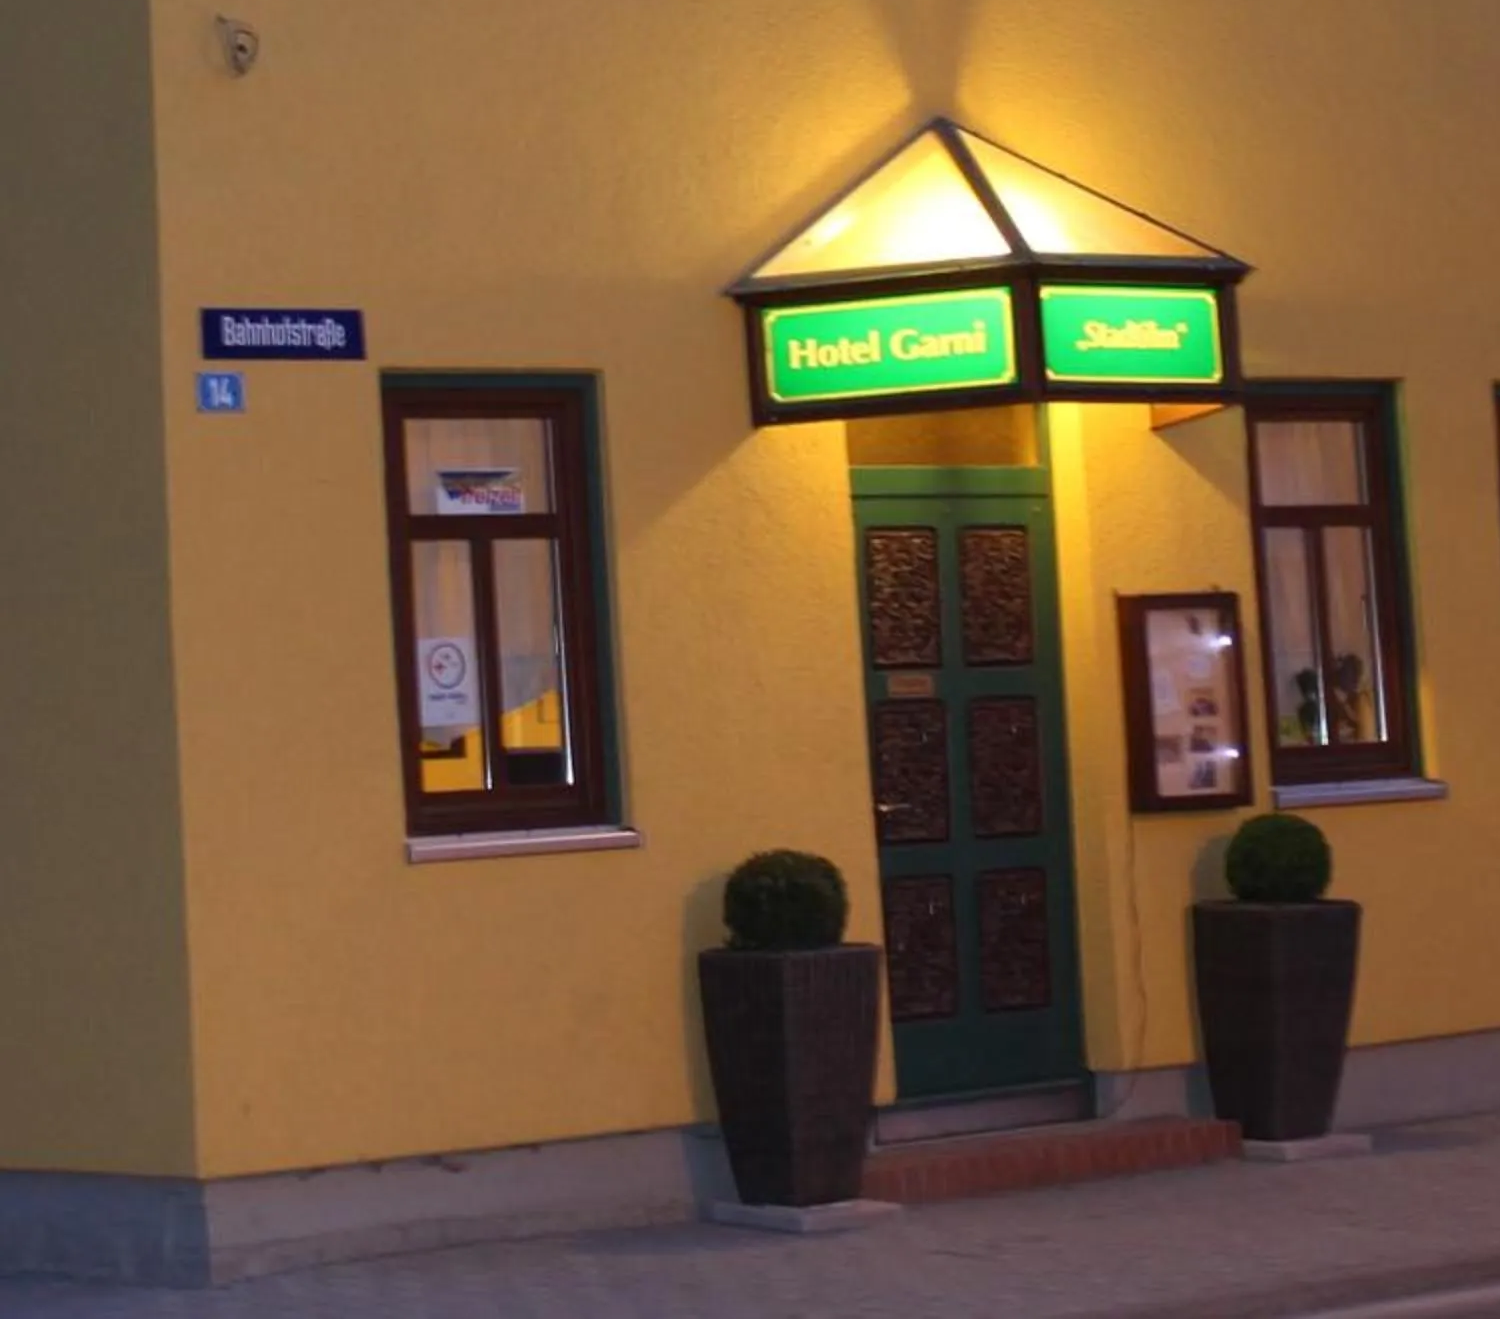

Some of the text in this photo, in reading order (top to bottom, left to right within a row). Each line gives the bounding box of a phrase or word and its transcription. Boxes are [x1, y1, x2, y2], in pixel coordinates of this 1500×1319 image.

[221, 315, 346, 350] Bahnhofstraße
[788, 320, 987, 370] Hotel Garni
[208, 377, 234, 408] 14
